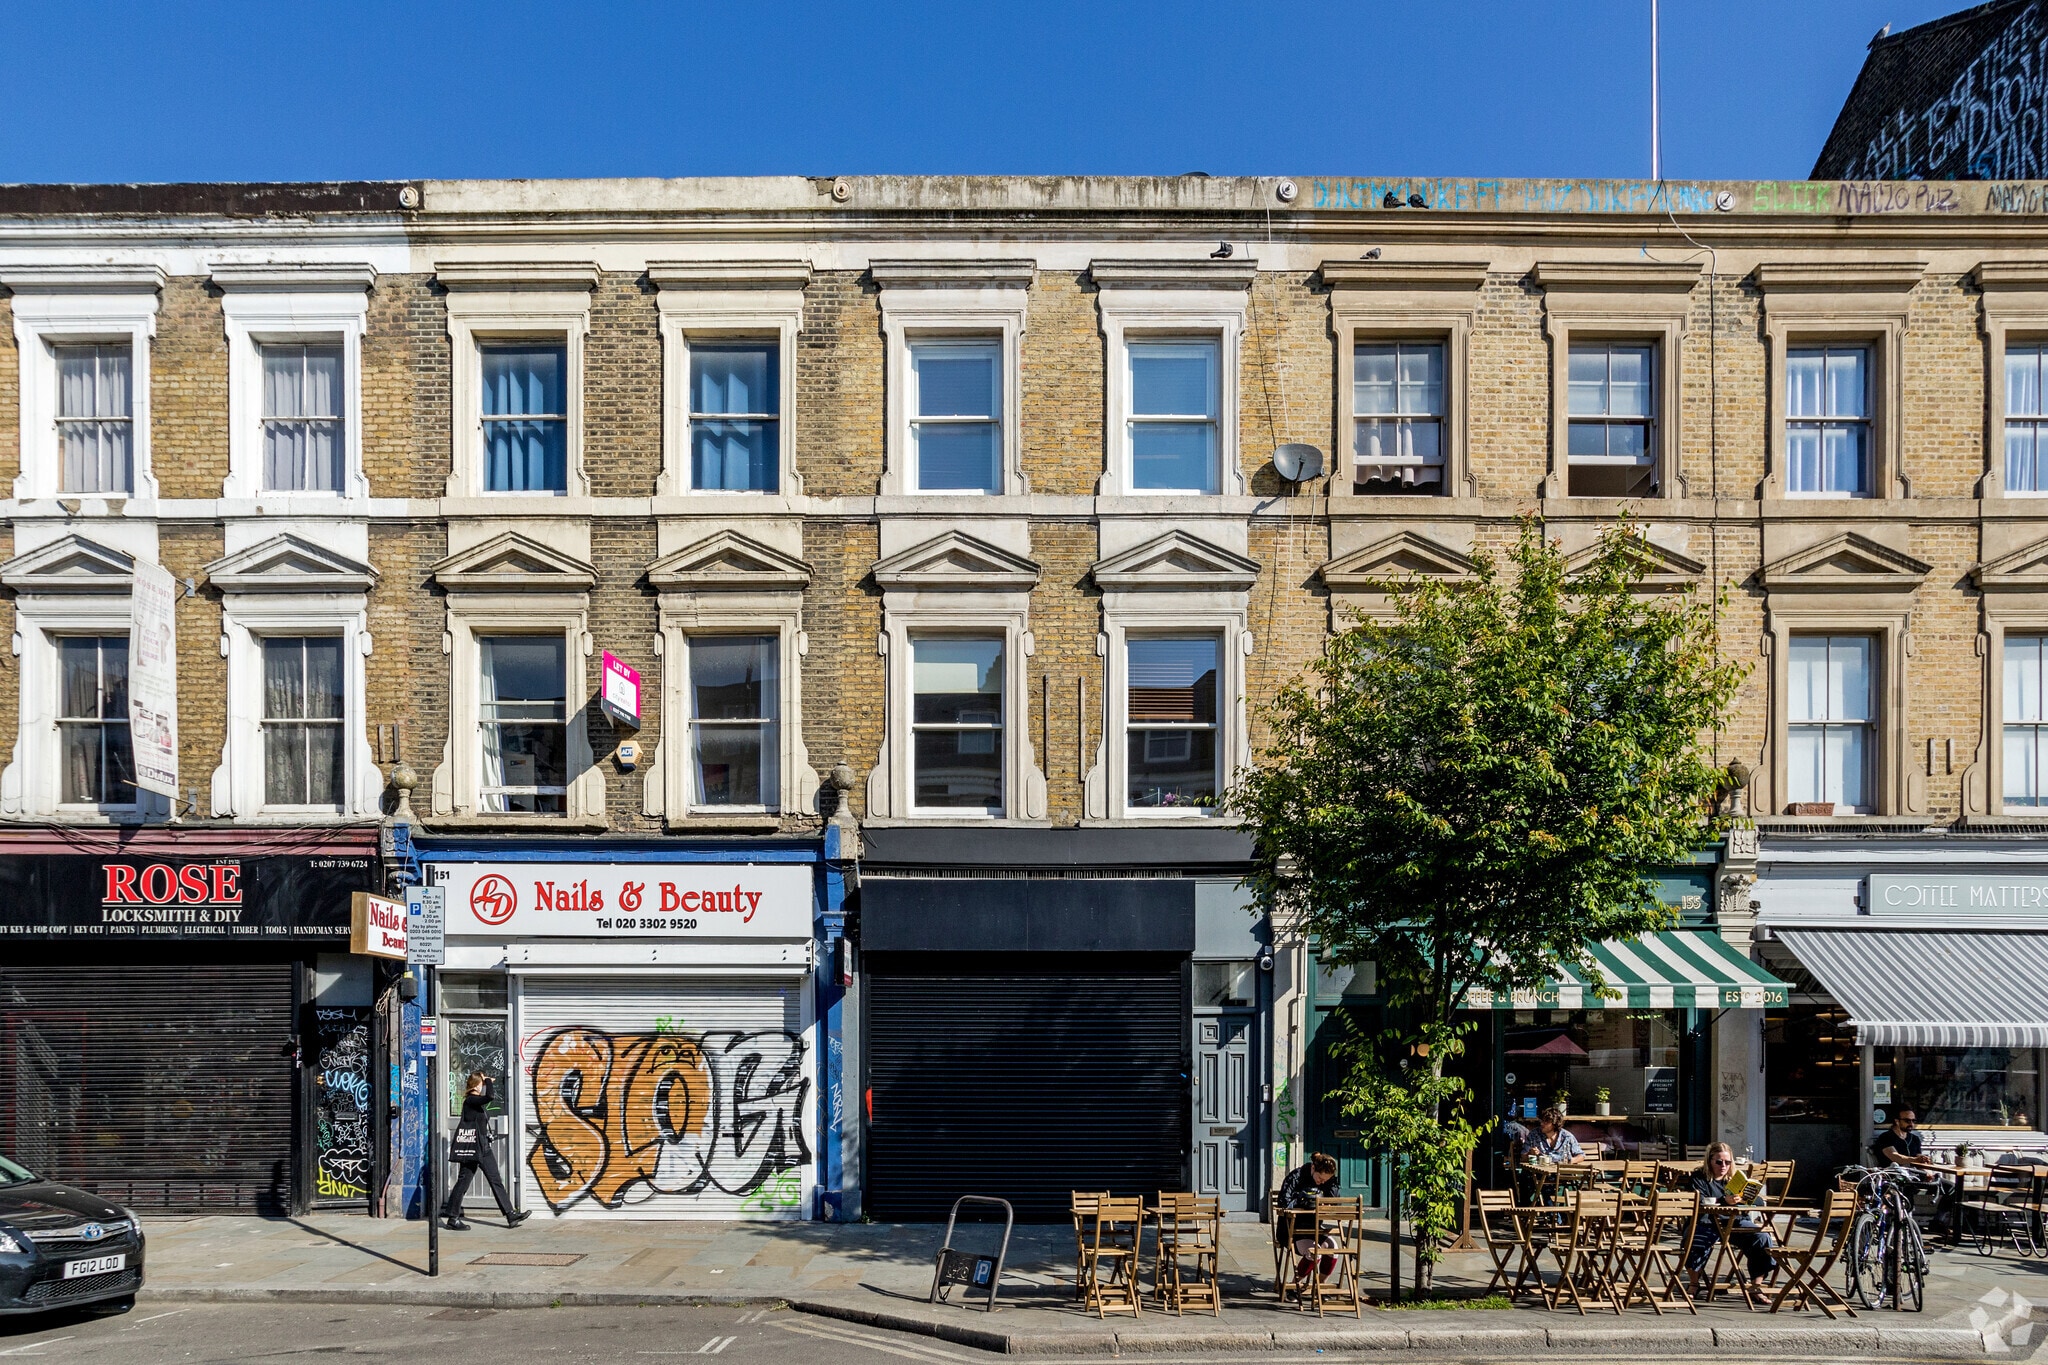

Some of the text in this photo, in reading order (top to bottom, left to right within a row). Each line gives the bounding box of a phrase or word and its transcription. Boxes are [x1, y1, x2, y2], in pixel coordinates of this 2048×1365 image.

[613, 660, 630, 679] LET BY
[147, 768, 174, 785] Dulux
[319, 860, 335, 868] 0207
[338, 860, 350, 868] 739
[352, 860, 368, 868] 6724
[434, 871, 450, 880] 151
[102, 864, 242, 904] ROSE
[534, 880, 763, 924] Nails & Beauty
[1681, 895, 1701, 910] 155
[1884, 884, 1959, 907] COFFEE
[102, 909, 243, 923] LOCKSMITH & DIY
[369, 902, 400, 931] Nails
[413, 904, 420, 915] P
[10, 926, 25, 934] KEY
[26, 926, 32, 934] &
[33, 926, 48, 934] FOB
[50, 926, 68, 934] COPY
[74, 926, 88, 934] KEY
[90, 926, 104, 934] CUT
[110, 926, 136, 934] PAINTS
[141, 926, 178, 934] PLUMBING
[185, 926, 225, 934] ELECTRICAL
[232, 926, 259, 934] TIMBER
[265, 926, 287, 934] TOOLS
[294, 926, 333, 935] HANDYMAN
[596, 918, 697, 929] Tel 020 3302 9520
[1498, 995, 1507, 1003] &
[1755, 991, 1783, 1003] 2016
[72, 1257, 119, 1275] FG12 LOD
